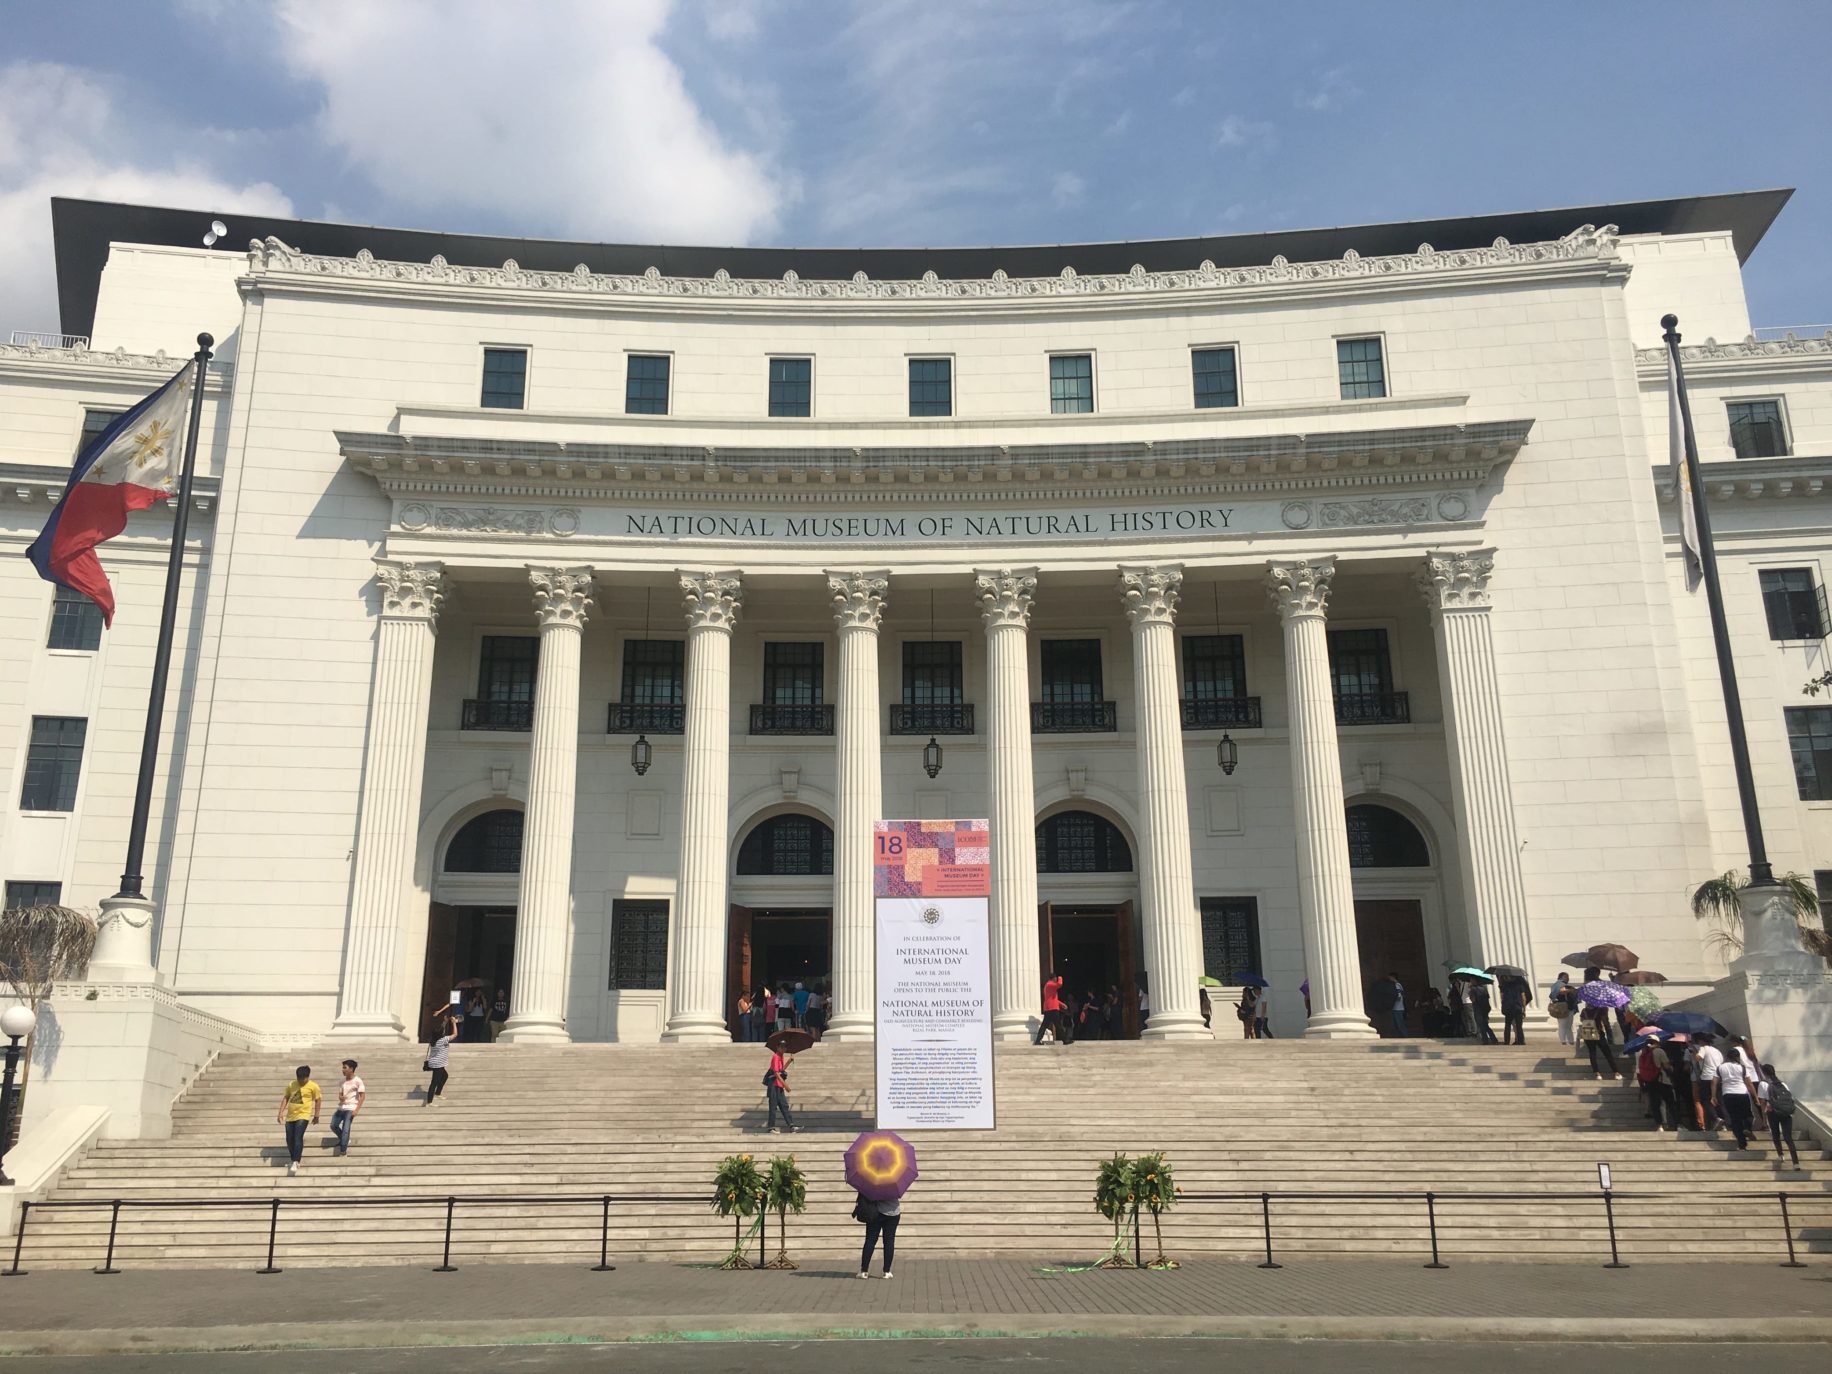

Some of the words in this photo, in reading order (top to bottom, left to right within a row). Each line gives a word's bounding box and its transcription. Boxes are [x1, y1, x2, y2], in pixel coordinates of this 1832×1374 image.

[626, 514, 774, 536] NATIONAL
[785, 518, 906, 537] MUSEUM
[918, 517, 953, 536] OF
[964, 514, 1099, 536] NATURAL
[1109, 509, 1234, 532] HISTORY
[878, 836, 903, 854] 18
[903, 957, 942, 965] MUSEUM
[944, 957, 962, 965] DAY
[892, 1009, 933, 1017] NATURAL
[936, 1009, 975, 1017] HISTORY
